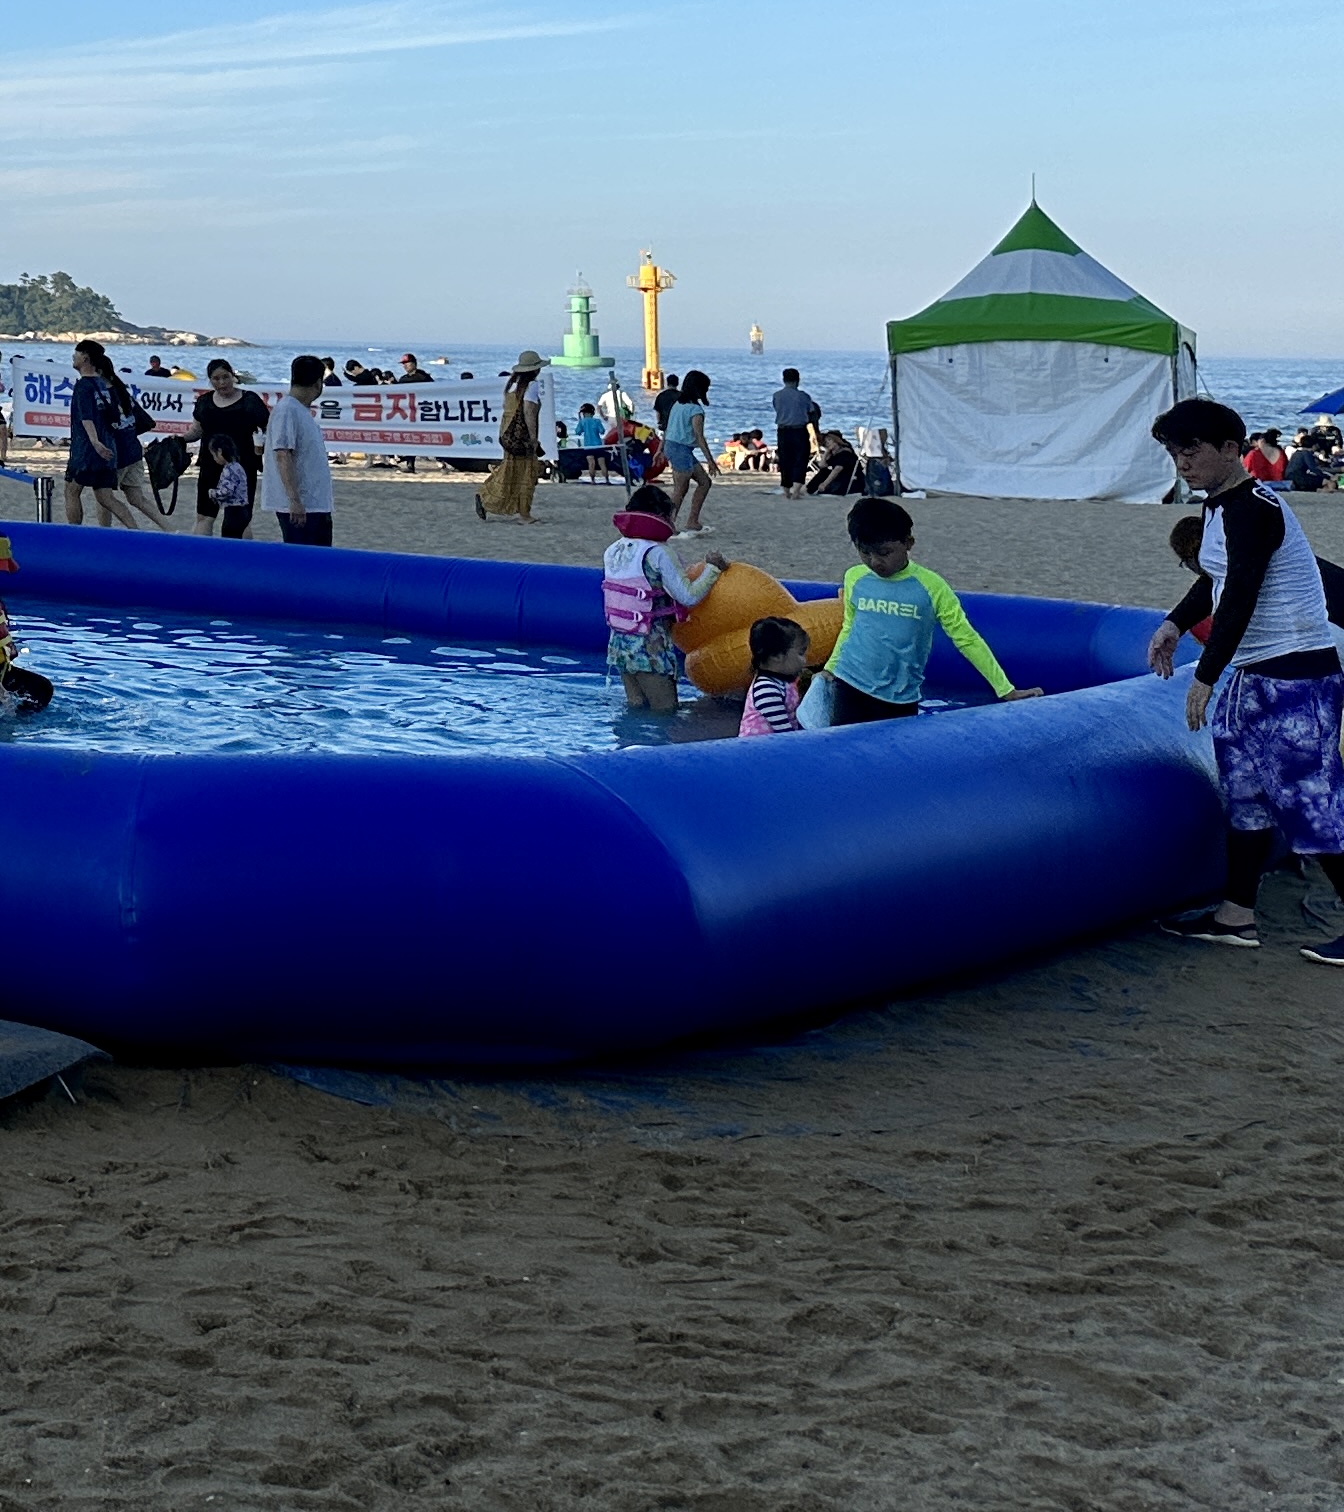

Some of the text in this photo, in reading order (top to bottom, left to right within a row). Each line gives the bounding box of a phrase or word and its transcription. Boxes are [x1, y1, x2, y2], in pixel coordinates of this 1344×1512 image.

[24, 372, 183, 413] 해수에서
[352, 392, 498, 423] 금지합니다.
[857, 597, 922, 620] BARREL
